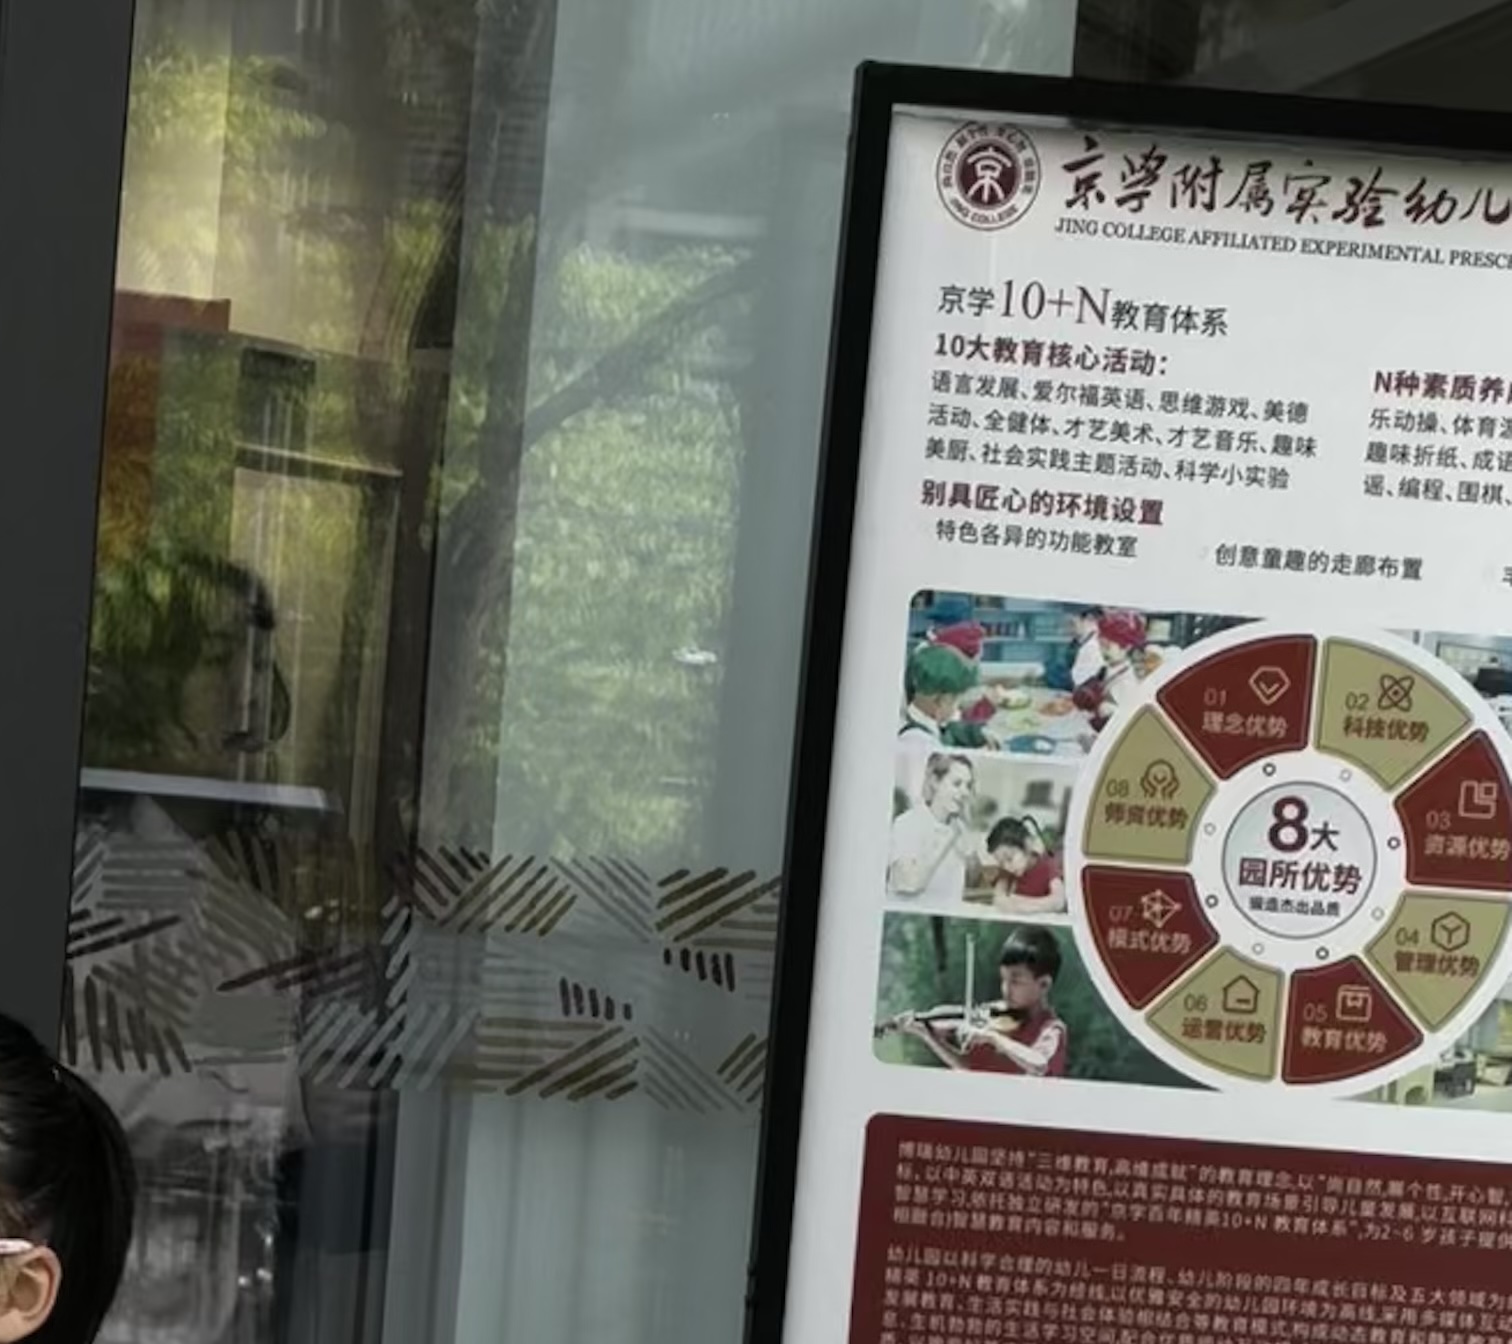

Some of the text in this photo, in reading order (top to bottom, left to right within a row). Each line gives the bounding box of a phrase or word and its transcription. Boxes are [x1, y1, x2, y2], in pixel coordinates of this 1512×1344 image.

[1054, 217, 1098, 237] JING
[1102, 221, 1186, 244] COLLEGE
[1189, 230, 1297, 253] AFFILIATED
[1301, 237, 1445, 265] EXPERIMENTAL
[937, 279, 1228, 337] 京学10+N教育体系
[1373, 369, 1512, 405] N种素质养
[920, 478, 1165, 527] 别具匠心的环境设置
[936, 518, 1138, 559] 特色各异的功能教室
[1214, 543, 1424, 581] 创意童趣的走廊布置
[1203, 688, 1228, 706] 01
[1345, 693, 1370, 711] 02
[1201, 710, 1289, 740] 理念优势
[1343, 716, 1430, 743] 科技优势
[1106, 779, 1130, 798] 08
[1267, 796, 1340, 854] 8大
[1426, 811, 1451, 830] 03
[1424, 836, 1511, 862] 资源优势
[1238, 855, 1363, 897] 园所优势
[1108, 904, 1133, 923] 07
[1107, 927, 1192, 956] 模式优势
[1395, 927, 1420, 946] 04
[1394, 950, 1480, 978] 管理优势
[1183, 993, 1208, 1013] 06
[1303, 1003, 1328, 1022] 05
[1181, 1016, 1267, 1044] 运营优势
[1300, 1026, 1387, 1054] 教育优势
